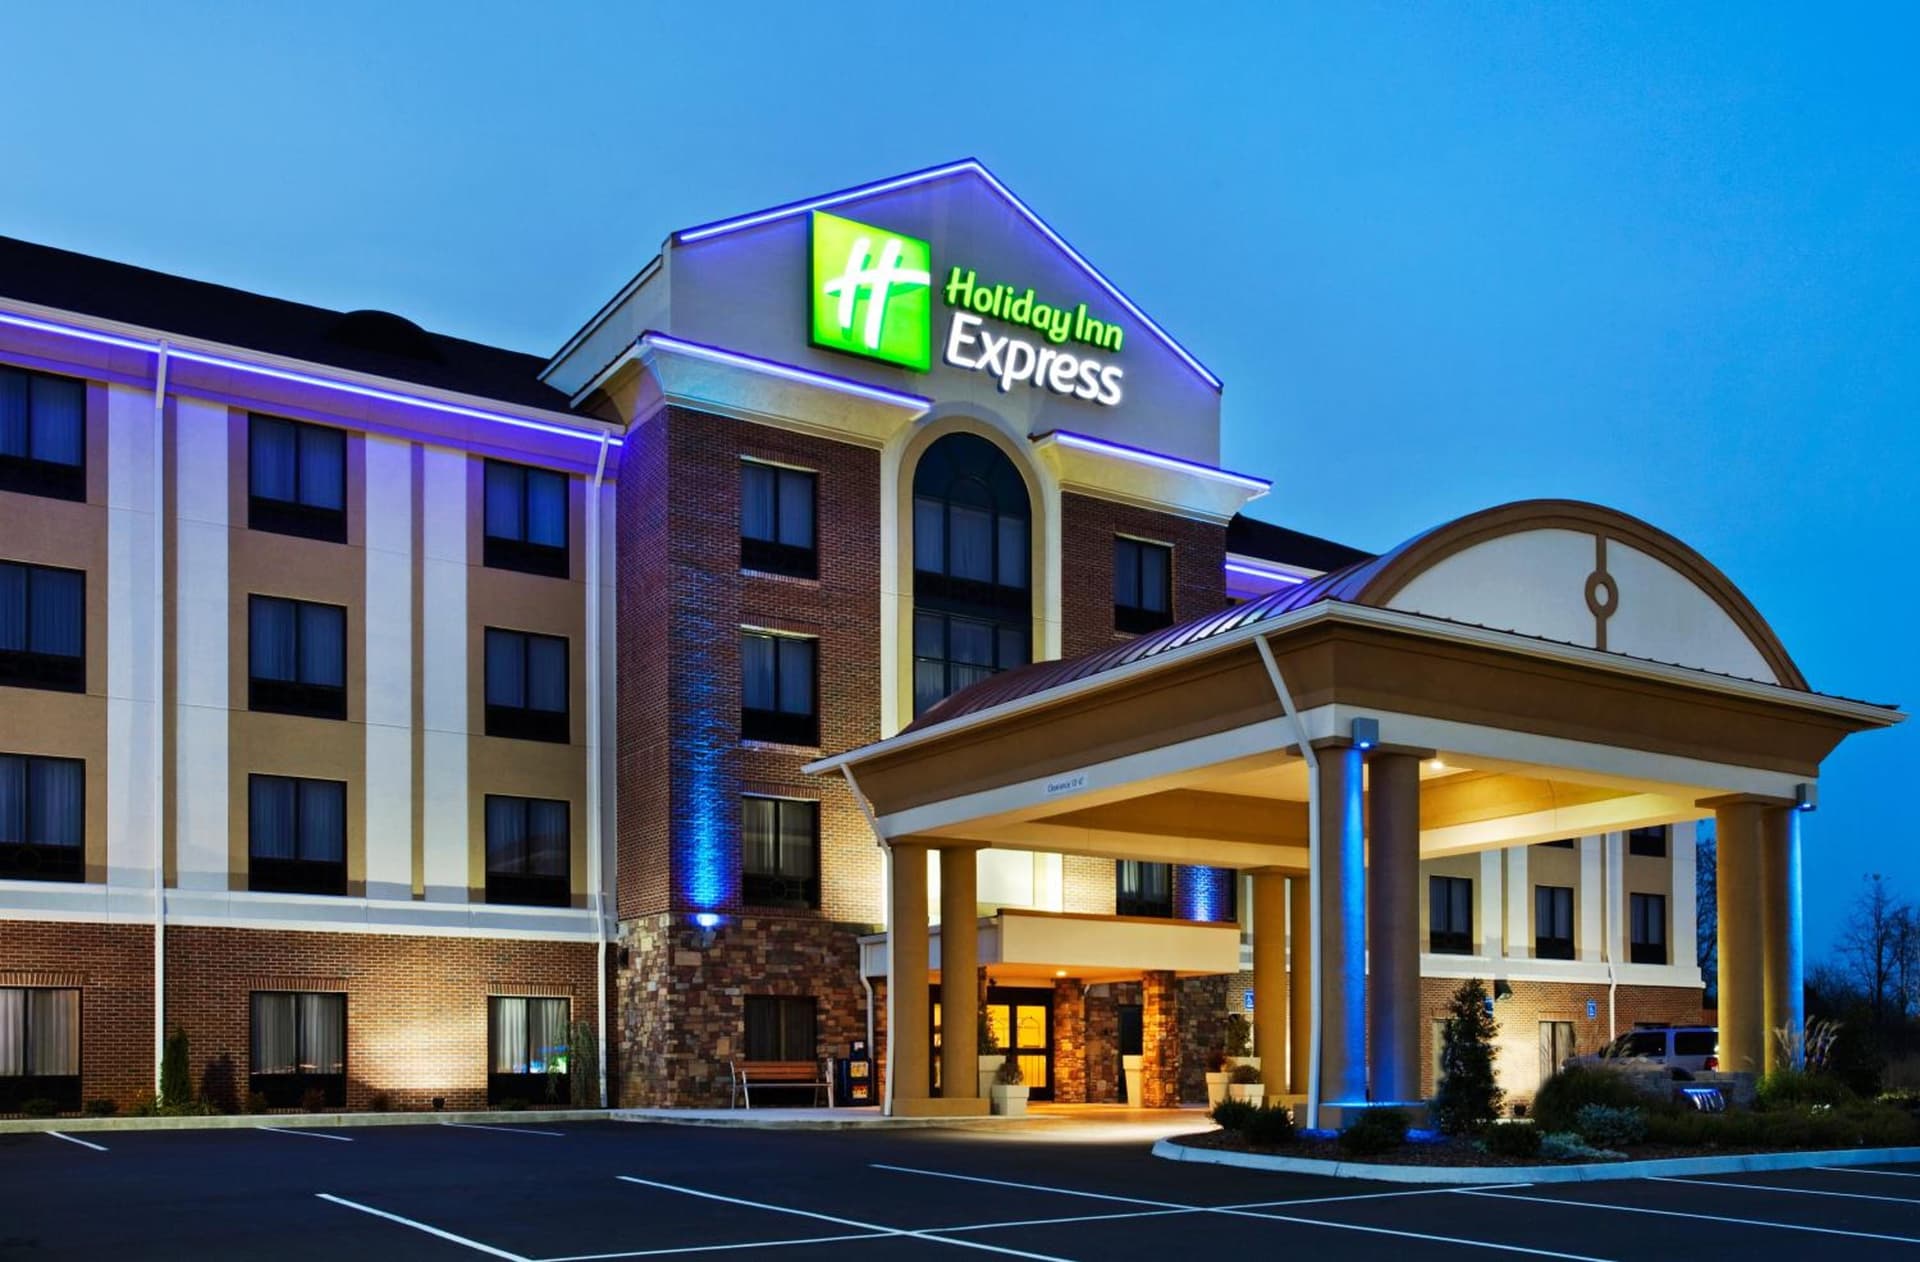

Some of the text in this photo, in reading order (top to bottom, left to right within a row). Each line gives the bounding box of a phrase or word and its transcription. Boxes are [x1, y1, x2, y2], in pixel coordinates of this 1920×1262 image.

[945, 266, 1124, 352] Holiday Inn
[945, 311, 1124, 406] Express
